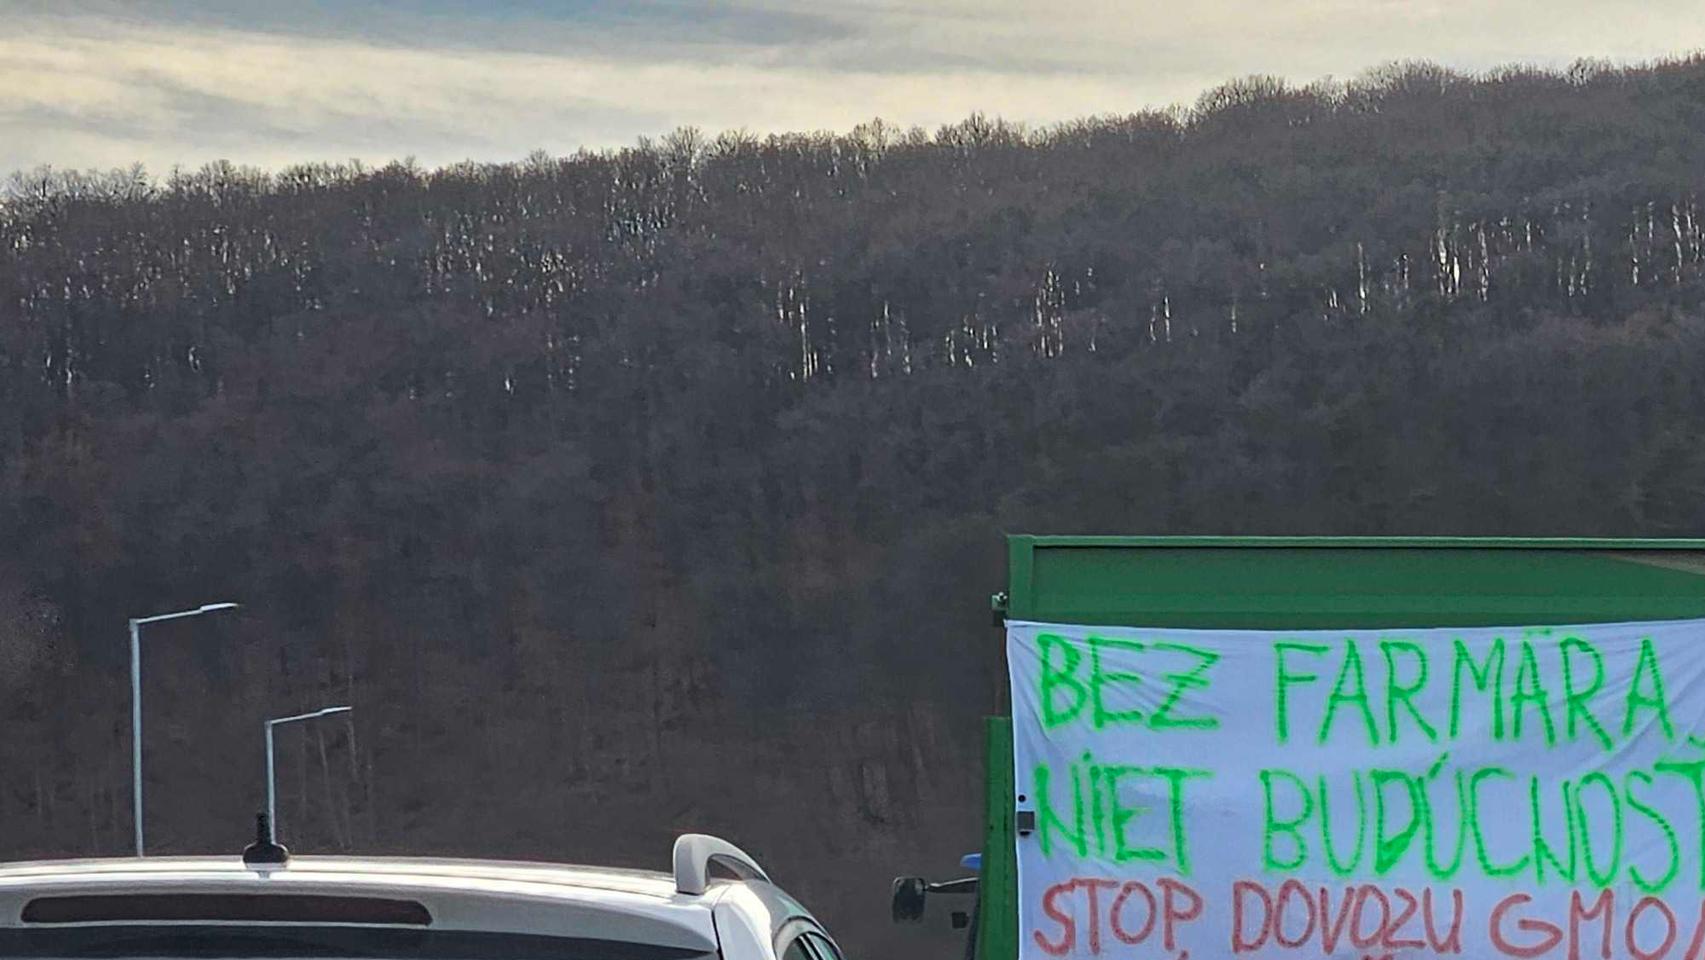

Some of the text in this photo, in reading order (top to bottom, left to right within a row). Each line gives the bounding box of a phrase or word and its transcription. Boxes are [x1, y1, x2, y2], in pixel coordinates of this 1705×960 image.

[1036, 634, 1220, 734] BEZ
[1034, 878, 1203, 957] STOP
[1231, 880, 1463, 955] DOVOZU
